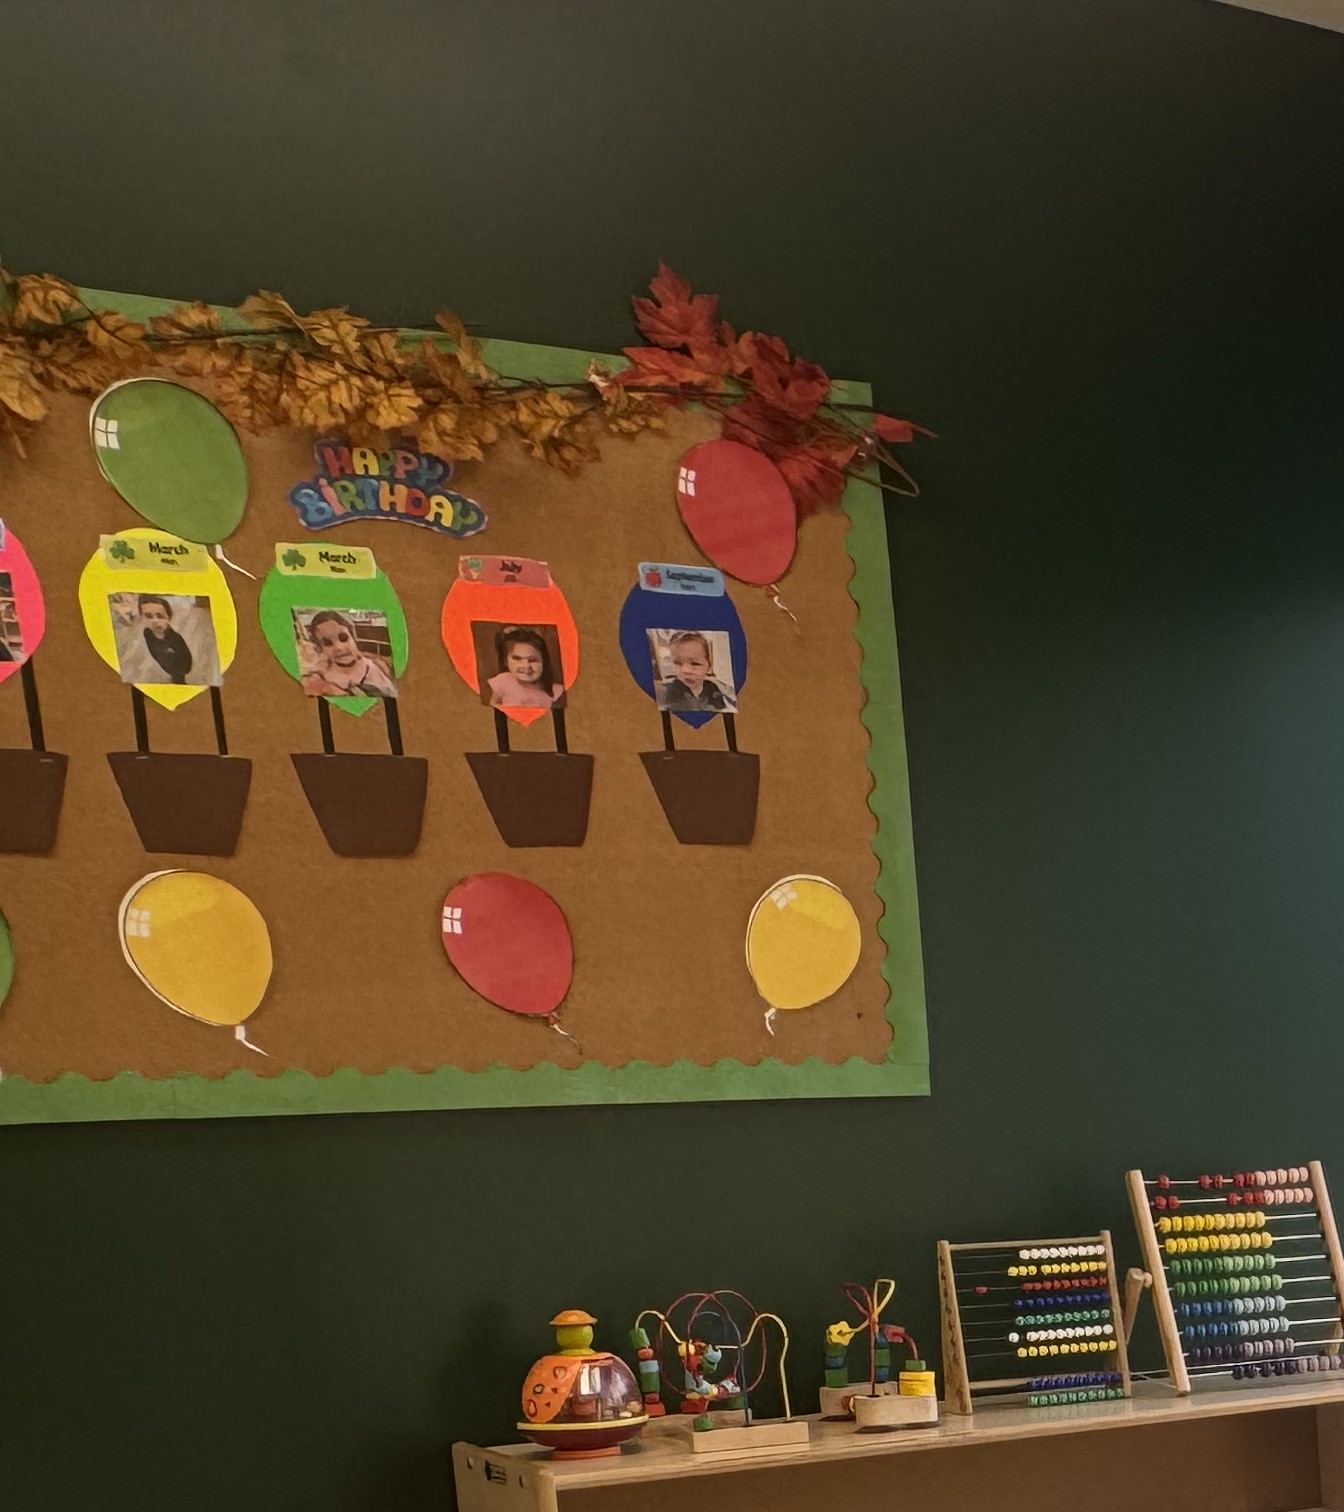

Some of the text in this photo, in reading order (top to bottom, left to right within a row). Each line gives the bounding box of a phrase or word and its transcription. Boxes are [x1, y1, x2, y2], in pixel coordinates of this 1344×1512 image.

[323, 446, 443, 488] HAPPY
[148, 542, 190, 556] March
[318, 551, 357, 565] March
